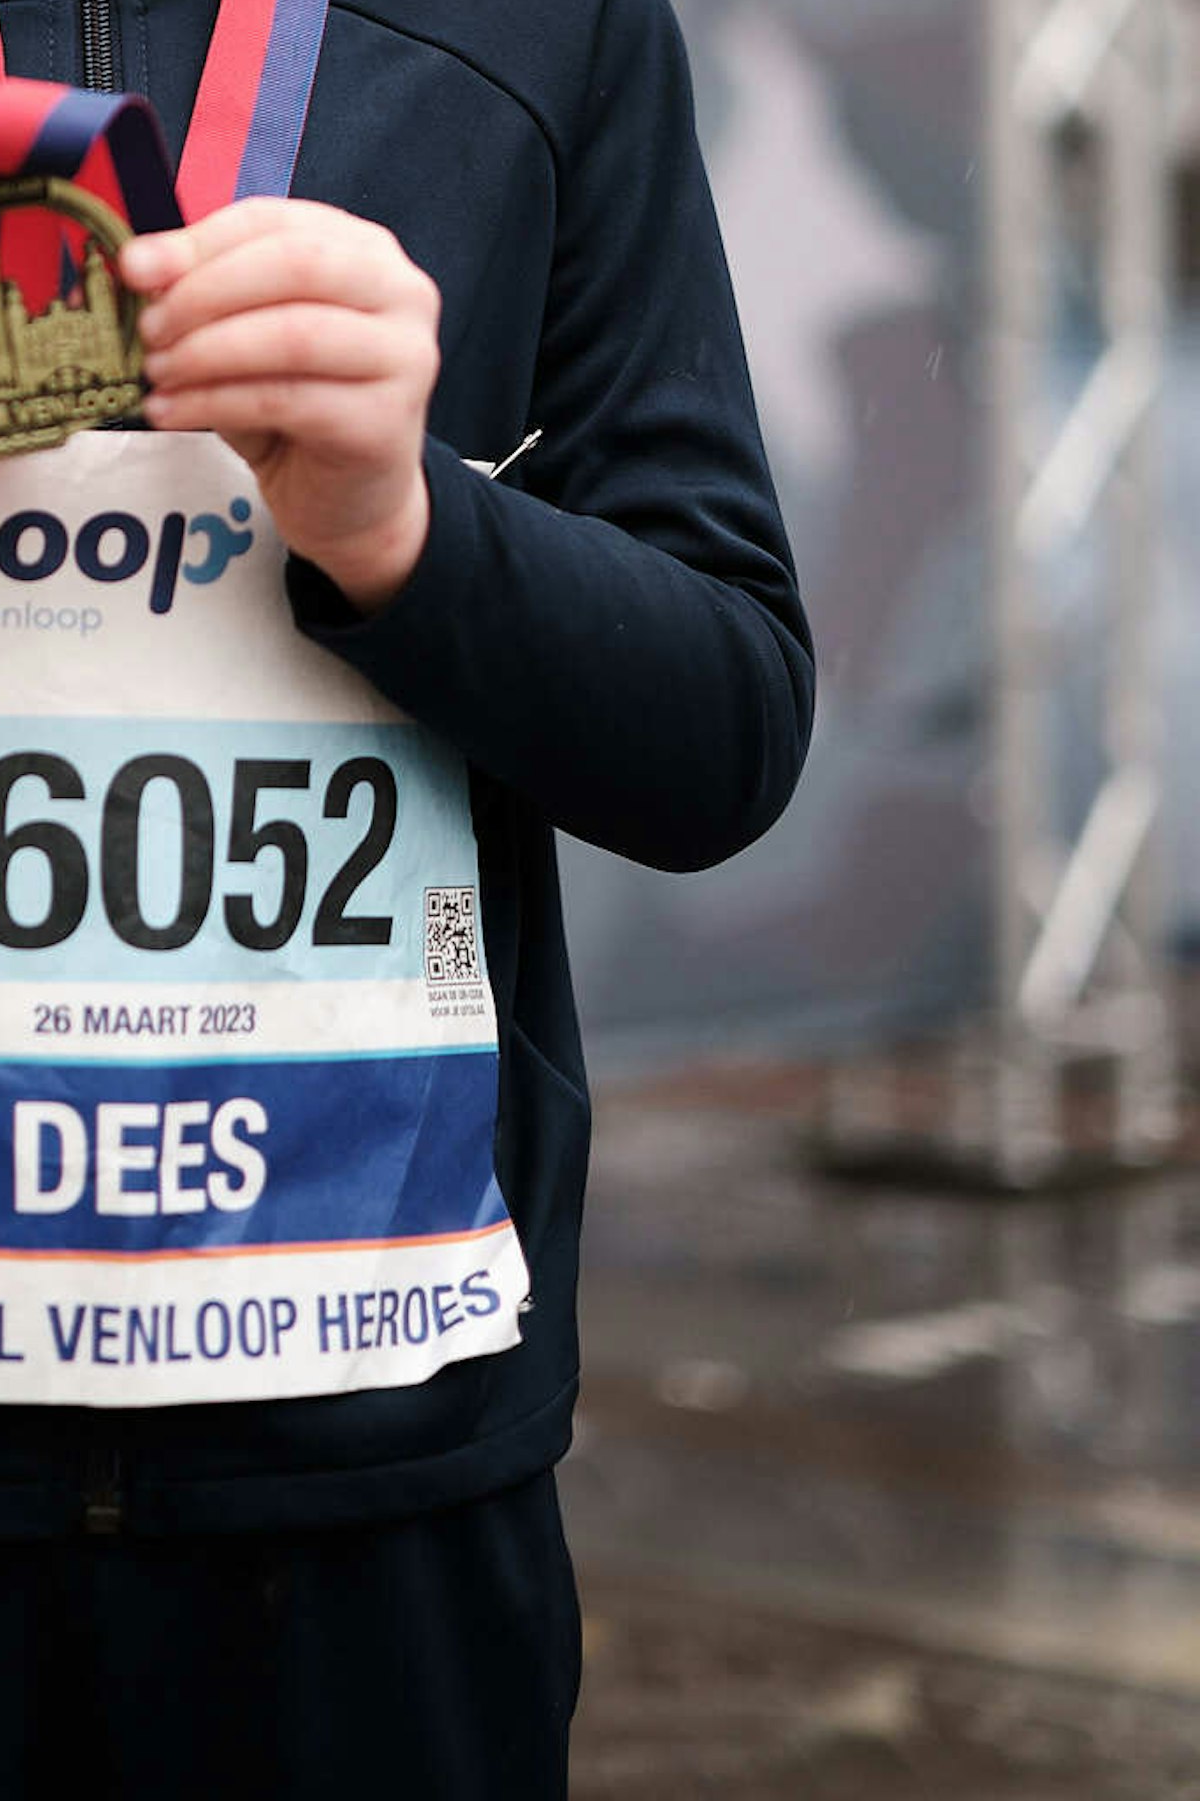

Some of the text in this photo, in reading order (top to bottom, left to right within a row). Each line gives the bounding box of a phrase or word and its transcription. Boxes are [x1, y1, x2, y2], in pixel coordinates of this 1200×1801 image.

[34, 1004, 256, 1035] 26 MAART 2023
[14, 1097, 268, 1217] DEES
[47, 1298, 297, 1365] VENLOOP
[318, 1269, 502, 1354] HEROES
